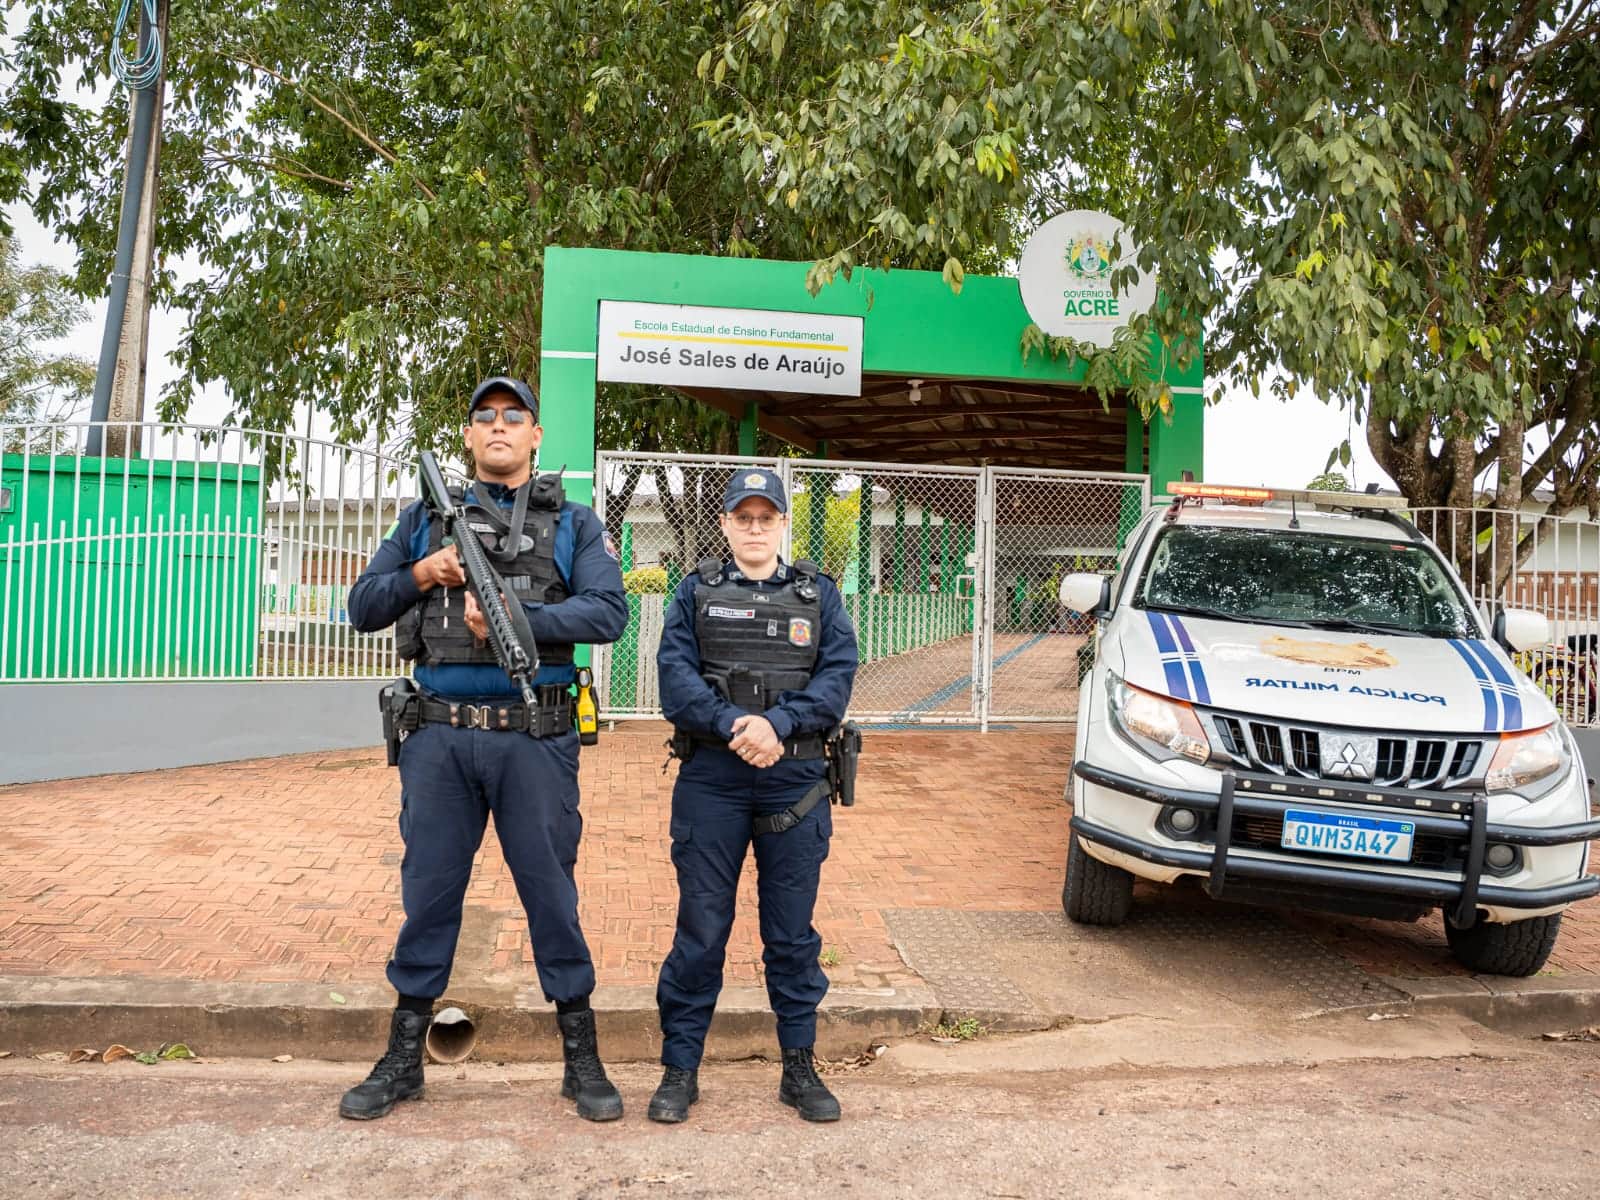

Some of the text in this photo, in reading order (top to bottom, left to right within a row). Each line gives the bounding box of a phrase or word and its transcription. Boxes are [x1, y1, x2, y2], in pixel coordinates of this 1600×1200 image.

[1064, 290, 1103, 298] GOVERNO
[1064, 299, 1119, 316] ACRE
[634, 319, 834, 342] Escola Estadual de Ensino Fundamental
[620, 345, 845, 379] José Sales de Araújo
[1338, 819, 1359, 827] BRASIL
[1295, 824, 1399, 855] QWM3A47
